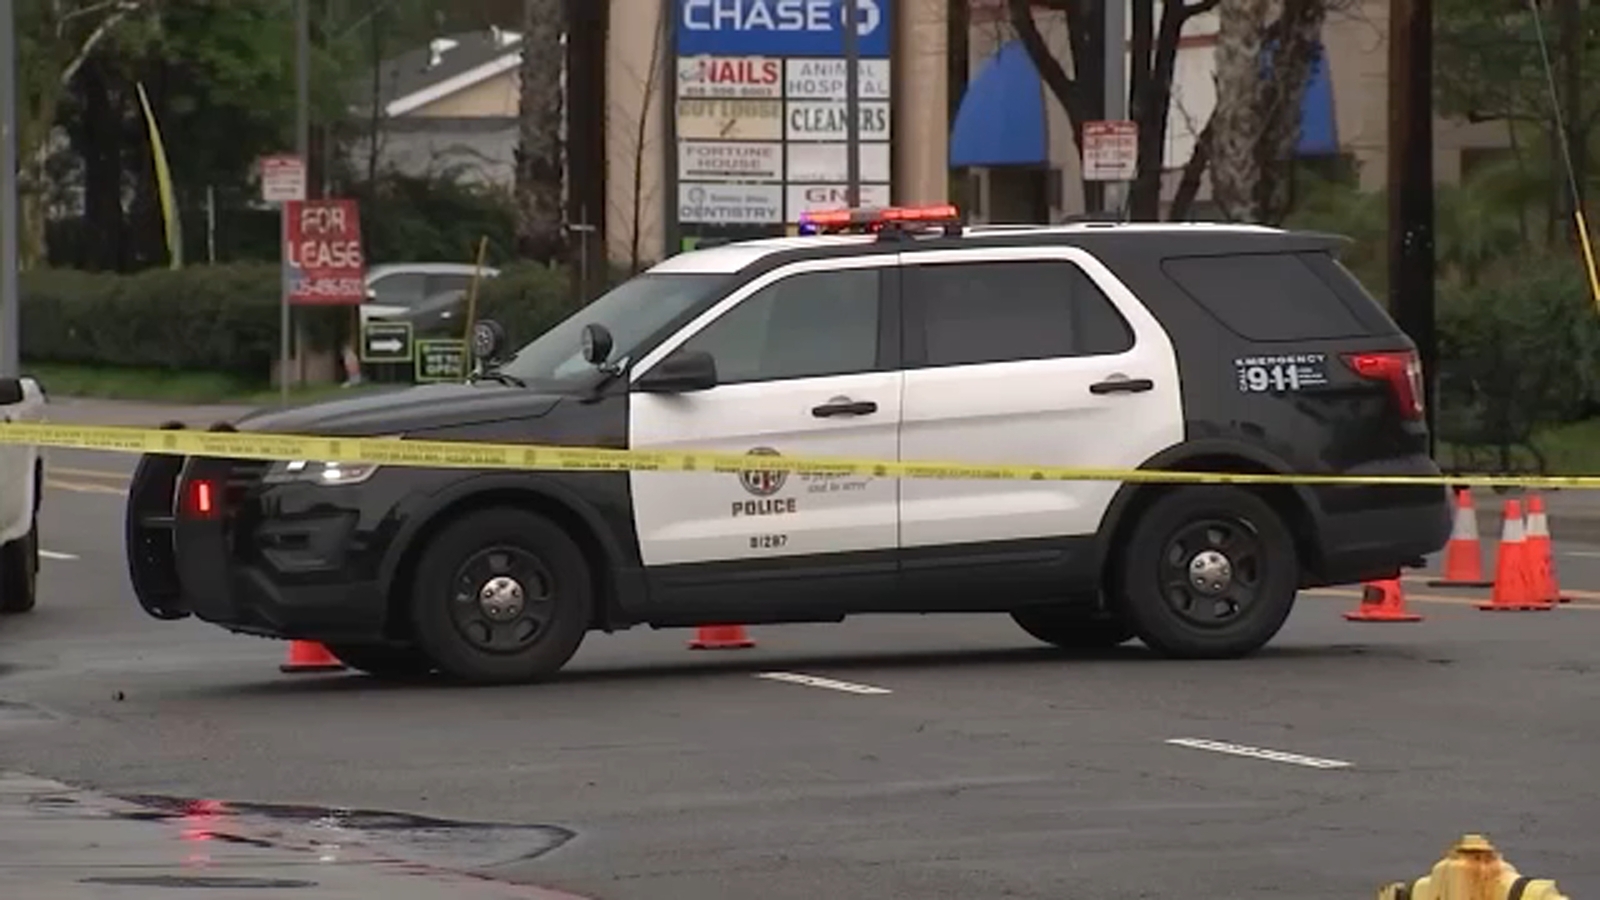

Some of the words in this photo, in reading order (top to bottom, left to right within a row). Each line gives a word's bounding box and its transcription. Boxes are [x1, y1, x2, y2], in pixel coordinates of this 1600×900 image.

[683, 0, 833, 31] CHASE
[698, 61, 779, 85] NAILS
[789, 79, 888, 94] HOSPAL
[686, 145, 773, 158] FORTUNE
[697, 158, 762, 169] HOUSE
[301, 207, 346, 234] FOR
[680, 206, 777, 218] DENTISTRY
[288, 241, 361, 269] LEASE
[1235, 354, 1326, 366] EMERGENCY
[732, 497, 797, 517] POLICE
